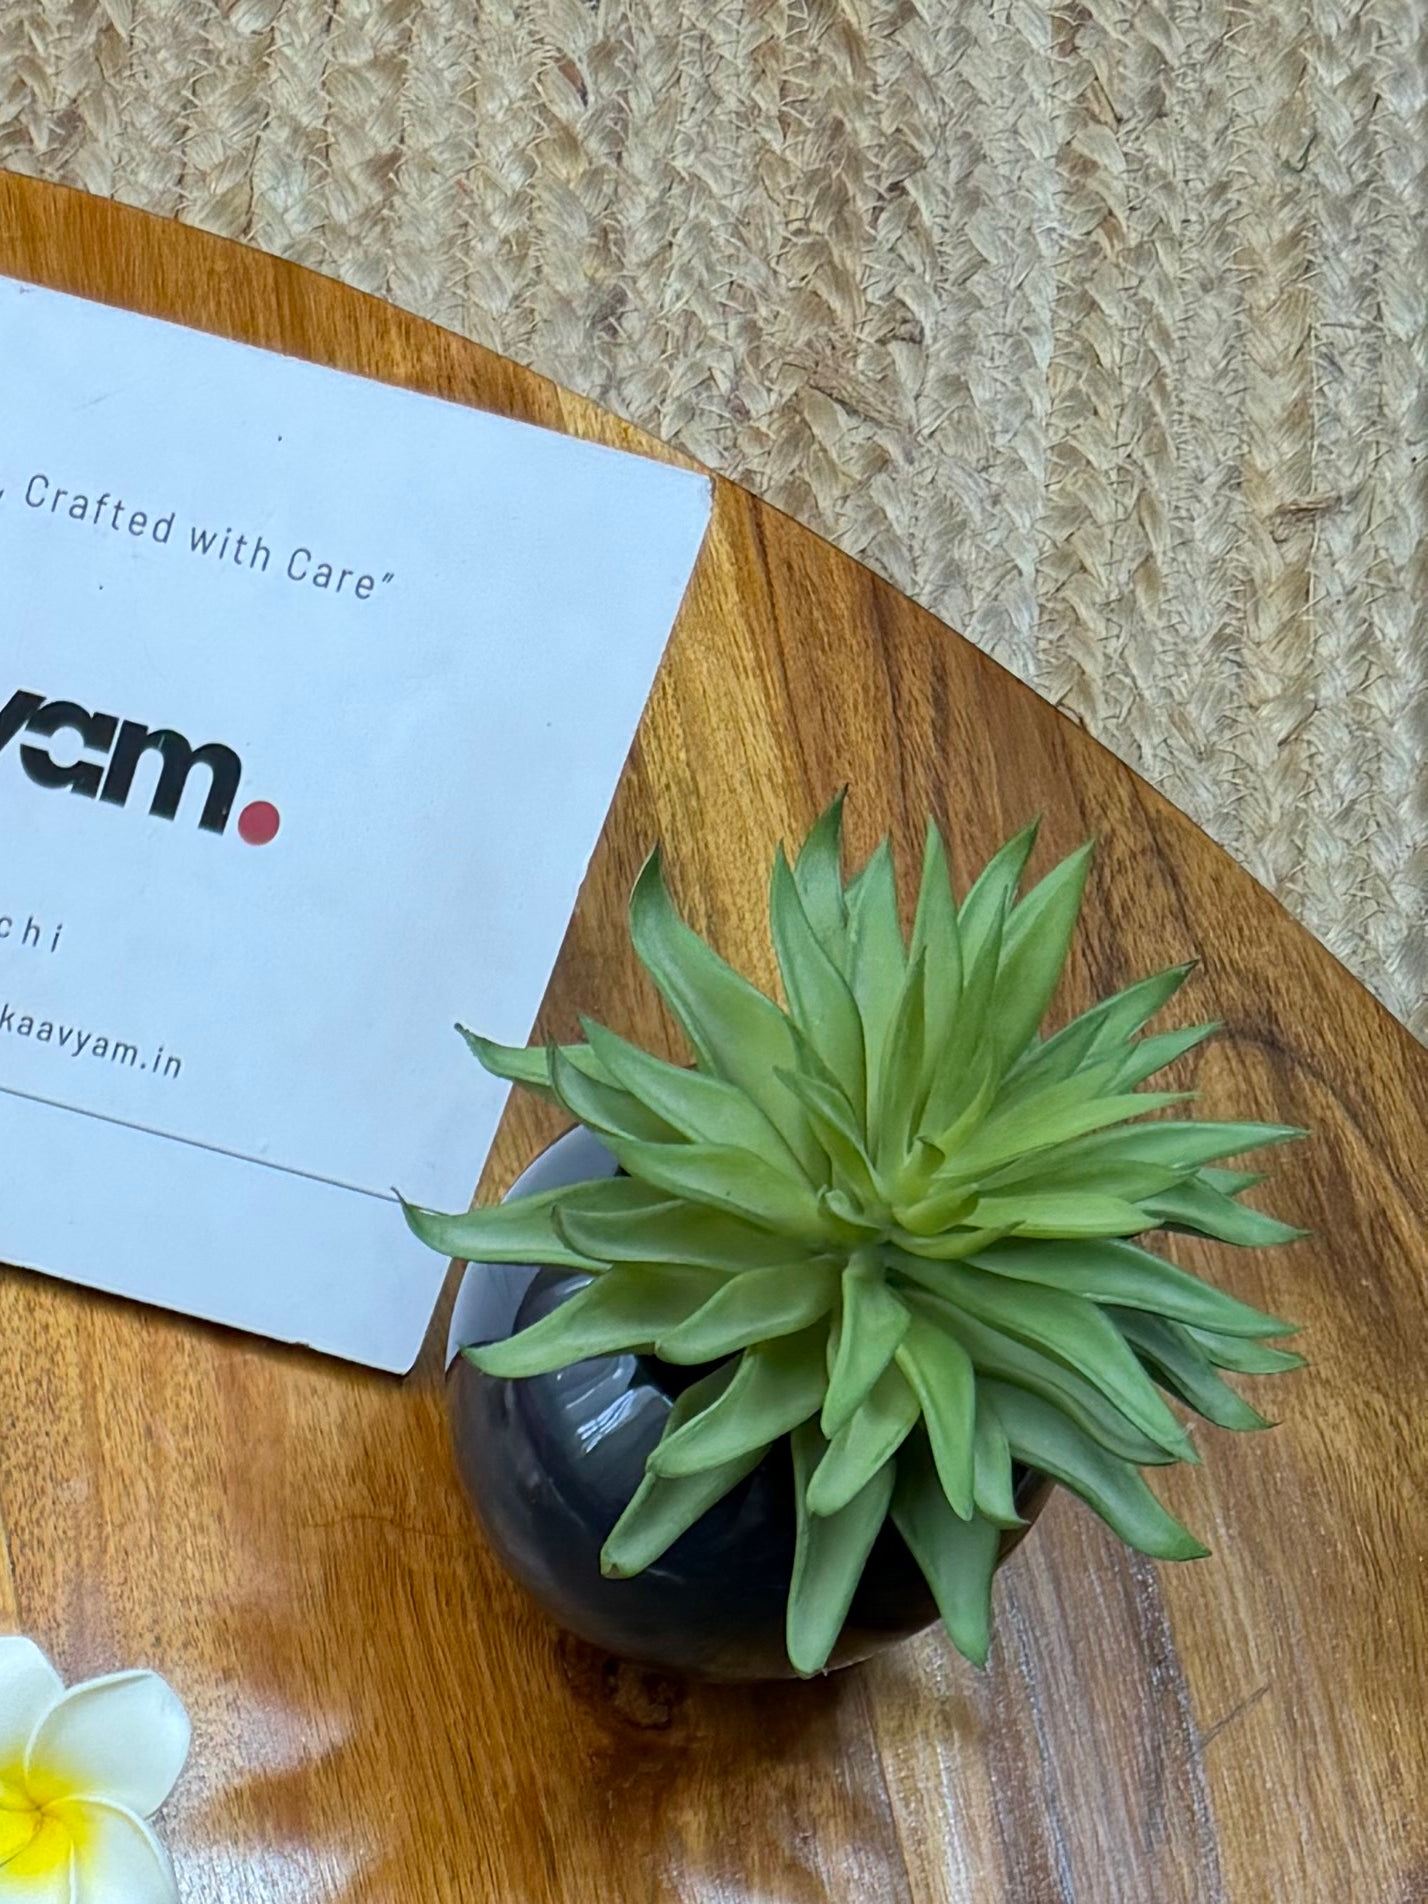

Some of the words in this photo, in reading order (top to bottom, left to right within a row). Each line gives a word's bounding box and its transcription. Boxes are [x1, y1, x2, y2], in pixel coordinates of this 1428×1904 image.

[25, 474, 176, 544] Crafted
[190, 526, 271, 572] with
[287, 547, 395, 600] Care"
